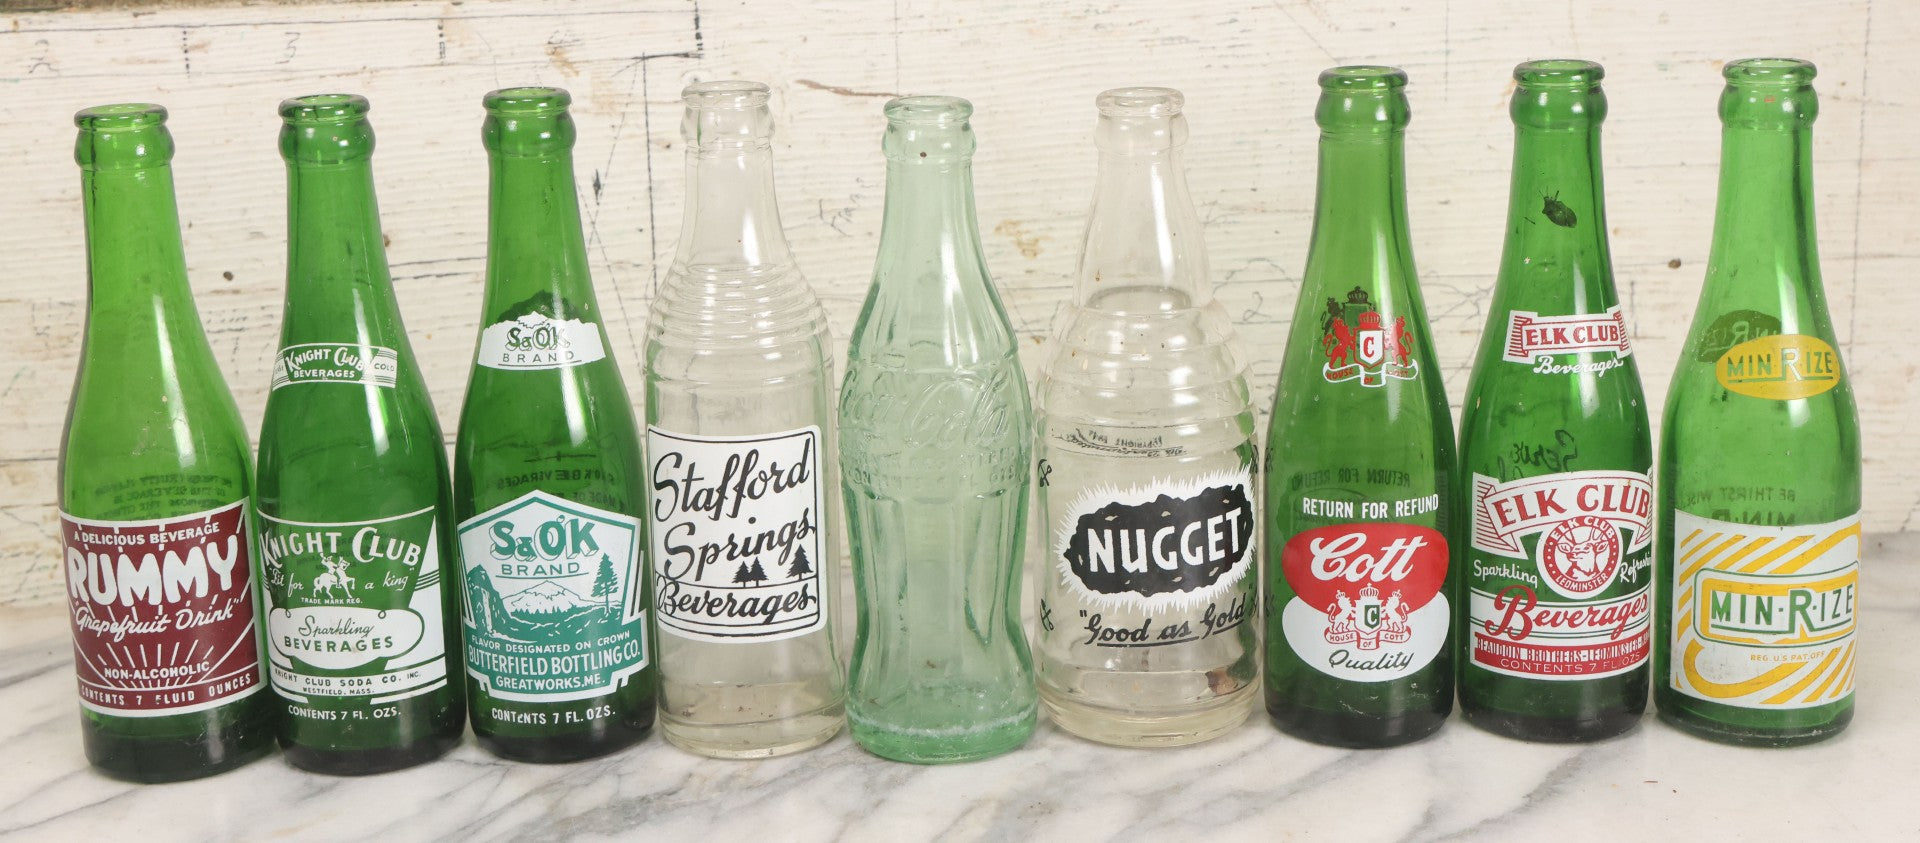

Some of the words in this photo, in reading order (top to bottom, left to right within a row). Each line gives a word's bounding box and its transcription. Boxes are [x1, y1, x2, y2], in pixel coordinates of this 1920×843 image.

[1363, 336, 1374, 358] C
[1525, 327, 1570, 346] ELK
[1573, 325, 1619, 344] CLUB
[285, 348, 332, 372] KNIGHT
[334, 347, 365, 371] CLUB
[503, 351, 574, 362] BRAND
[1533, 356, 1623, 378] Beverages
[293, 369, 355, 378] BEVERAGES
[653, 437, 811, 522] Stafford
[1302, 497, 1354, 518] RETURN
[1361, 502, 1388, 519] FOR
[1395, 493, 1439, 517] REFUND
[1491, 488, 1567, 528] ELK
[1576, 484, 1650, 518] CLUB
[74, 533, 80, 542] A
[82, 532, 145, 545] DELICIOUS
[150, 522, 220, 544] BEVERAGE
[1550, 517, 1579, 540] ELK
[1584, 516, 1615, 539] CLUB
[259, 528, 343, 569] KNIGHT
[352, 527, 421, 566] CLUB
[664, 507, 816, 582] Springs
[1087, 507, 1242, 574] NUGGET
[501, 562, 580, 576] BRAND
[1310, 532, 1428, 583] Cott
[67, 535, 238, 606] RUMMY
[1473, 559, 1538, 588] Sparkling
[1556, 572, 1608, 592] LEOMINSTER
[288, 573, 304, 597] for
[656, 575, 817, 625] Beverages
[1367, 608, 1378, 626] C
[1484, 584, 1649, 641] Beverages
[299, 615, 374, 639] Sparkling
[1157, 620, 1193, 640] as
[1329, 632, 1354, 642] HOUSE
[1384, 632, 1404, 641] COTT
[284, 636, 393, 652] BEVERAGES
[472, 635, 501, 651] FLAVOR
[506, 643, 570, 654] DESIGNATED
[576, 641, 591, 651] ON
[597, 630, 630, 646] CROWN
[1477, 638, 1521, 660] BEAUDOIN
[469, 645, 548, 676] BUTTERFIELD
[551, 645, 622, 674] BOTTLING
[624, 639, 641, 660] CO.
[1328, 649, 1415, 671] Quality
[1501, 658, 1583, 673] CONTENTS
[1588, 663, 1597, 672] 7
[104, 661, 210, 680] NON-ALCOHOLIC
[275, 668, 298, 682] KNIGHT
[305, 677, 331, 686] CLUB
[340, 678, 372, 686] SODA
[382, 674, 401, 683] CO.
[81, 685, 125, 705] CONTENTS
[136, 695, 143, 705] 7
[156, 691, 195, 704] FLUID
[209, 673, 251, 696] OUNCES
[288, 705, 336, 720] CONTENTS
[341, 711, 347, 720] 7
[353, 711, 368, 719] FL.
[373, 707, 401, 718] OZS.
[491, 708, 547, 725] CONTENTS
[553, 713, 559, 724] 7
[566, 711, 583, 723] FL.
[586, 705, 616, 720] OZS.
